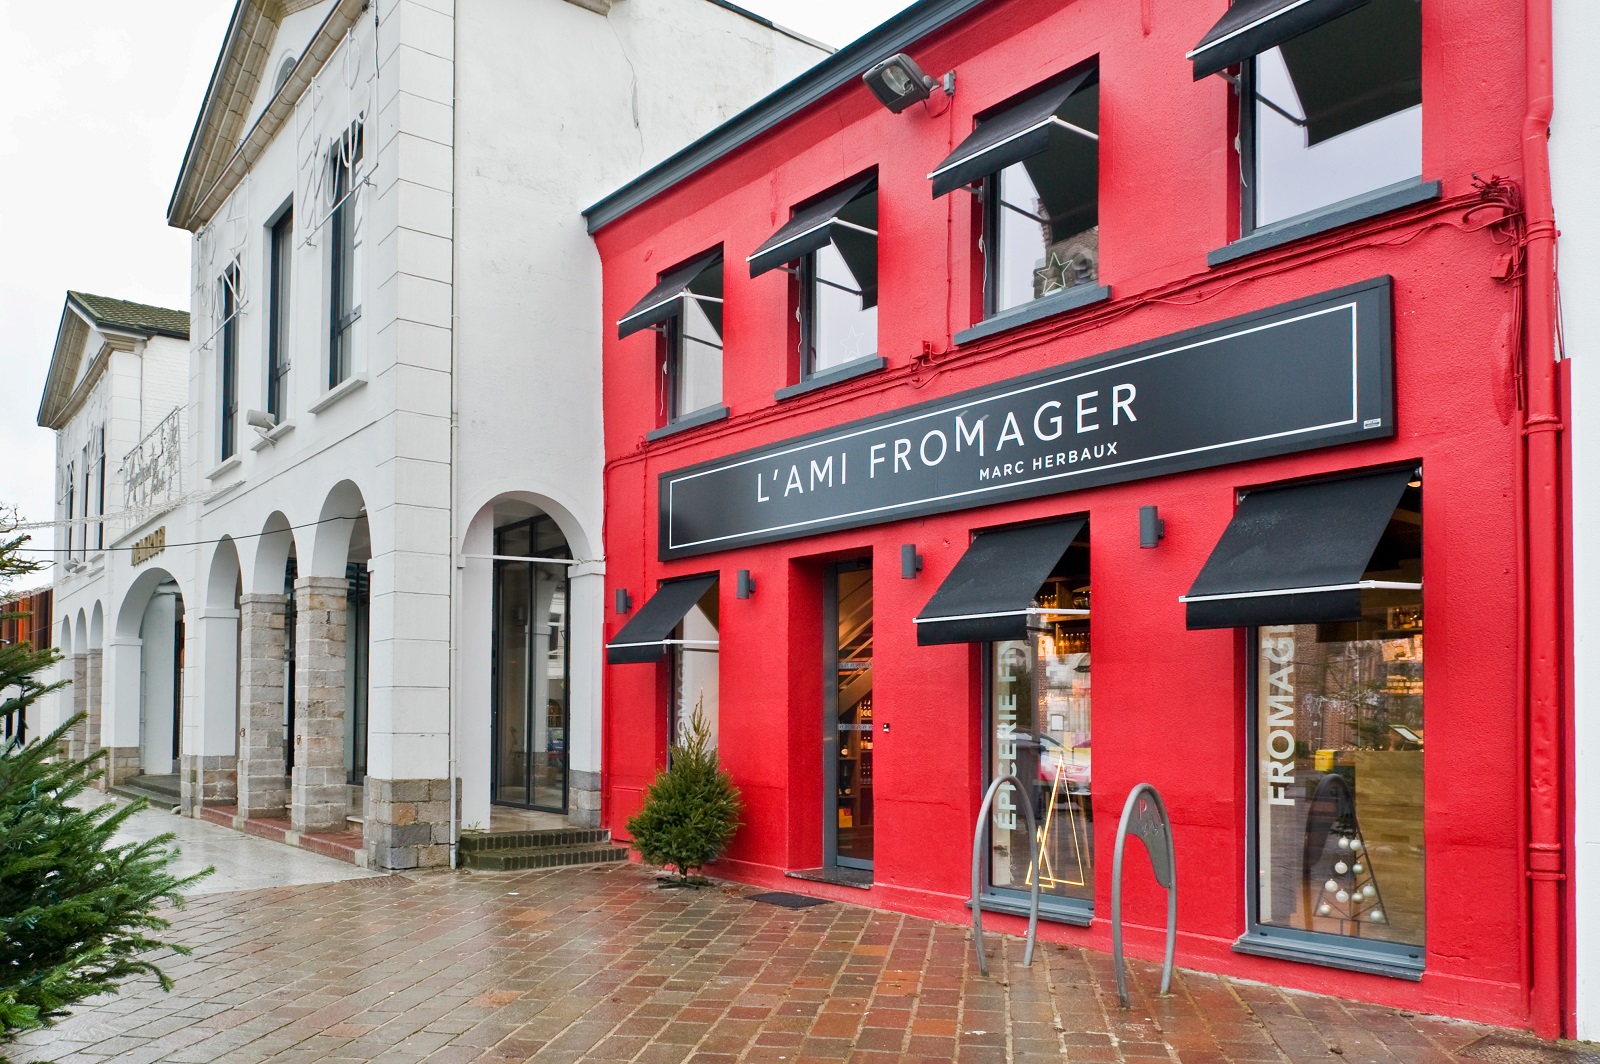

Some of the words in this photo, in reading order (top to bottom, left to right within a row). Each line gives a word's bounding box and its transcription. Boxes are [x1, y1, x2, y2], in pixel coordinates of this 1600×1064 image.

[757, 452, 846, 503] L'AMI
[869, 384, 1137, 479] FROMAGER
[979, 461, 1024, 481] MARC
[1032, 441, 1118, 470] HERBAUX
